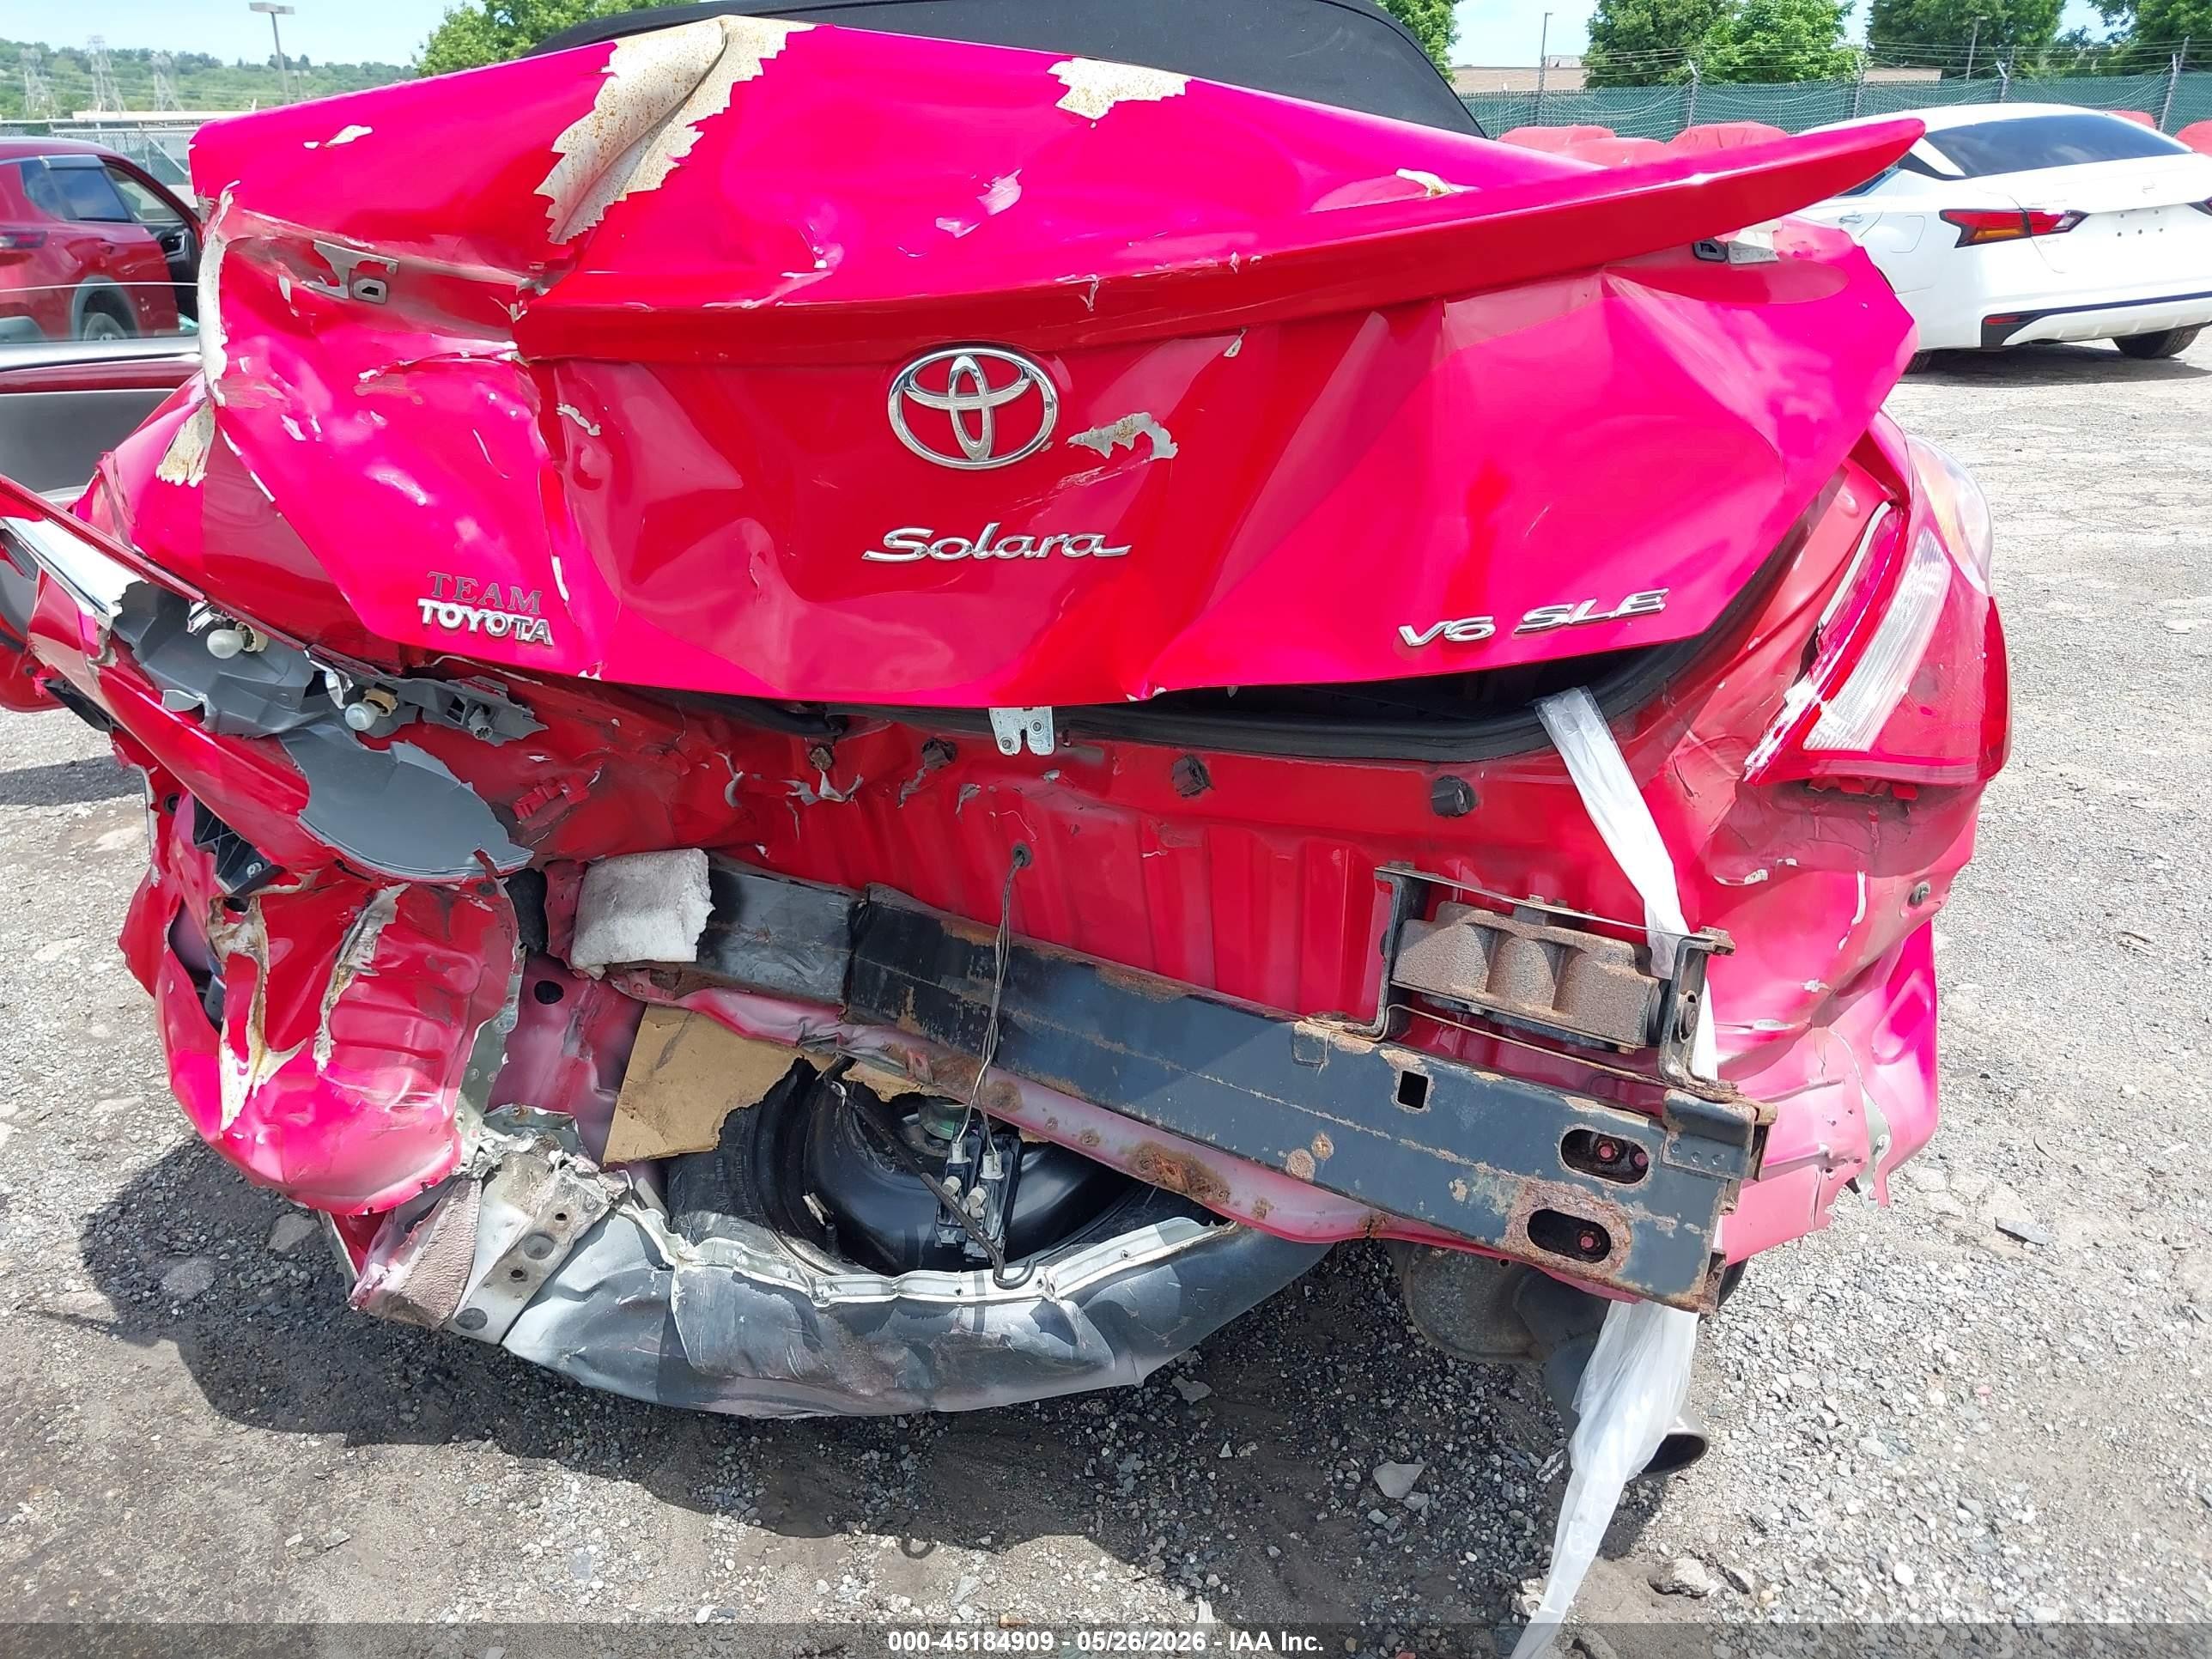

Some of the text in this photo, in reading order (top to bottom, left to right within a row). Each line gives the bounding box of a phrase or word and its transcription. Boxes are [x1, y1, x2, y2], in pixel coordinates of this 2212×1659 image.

[861, 522, 1132, 562] Solara
[427, 571, 543, 615] TEAM
[417, 599, 555, 646] TOYOTA
[1398, 587, 1670, 647] V6 SLE
